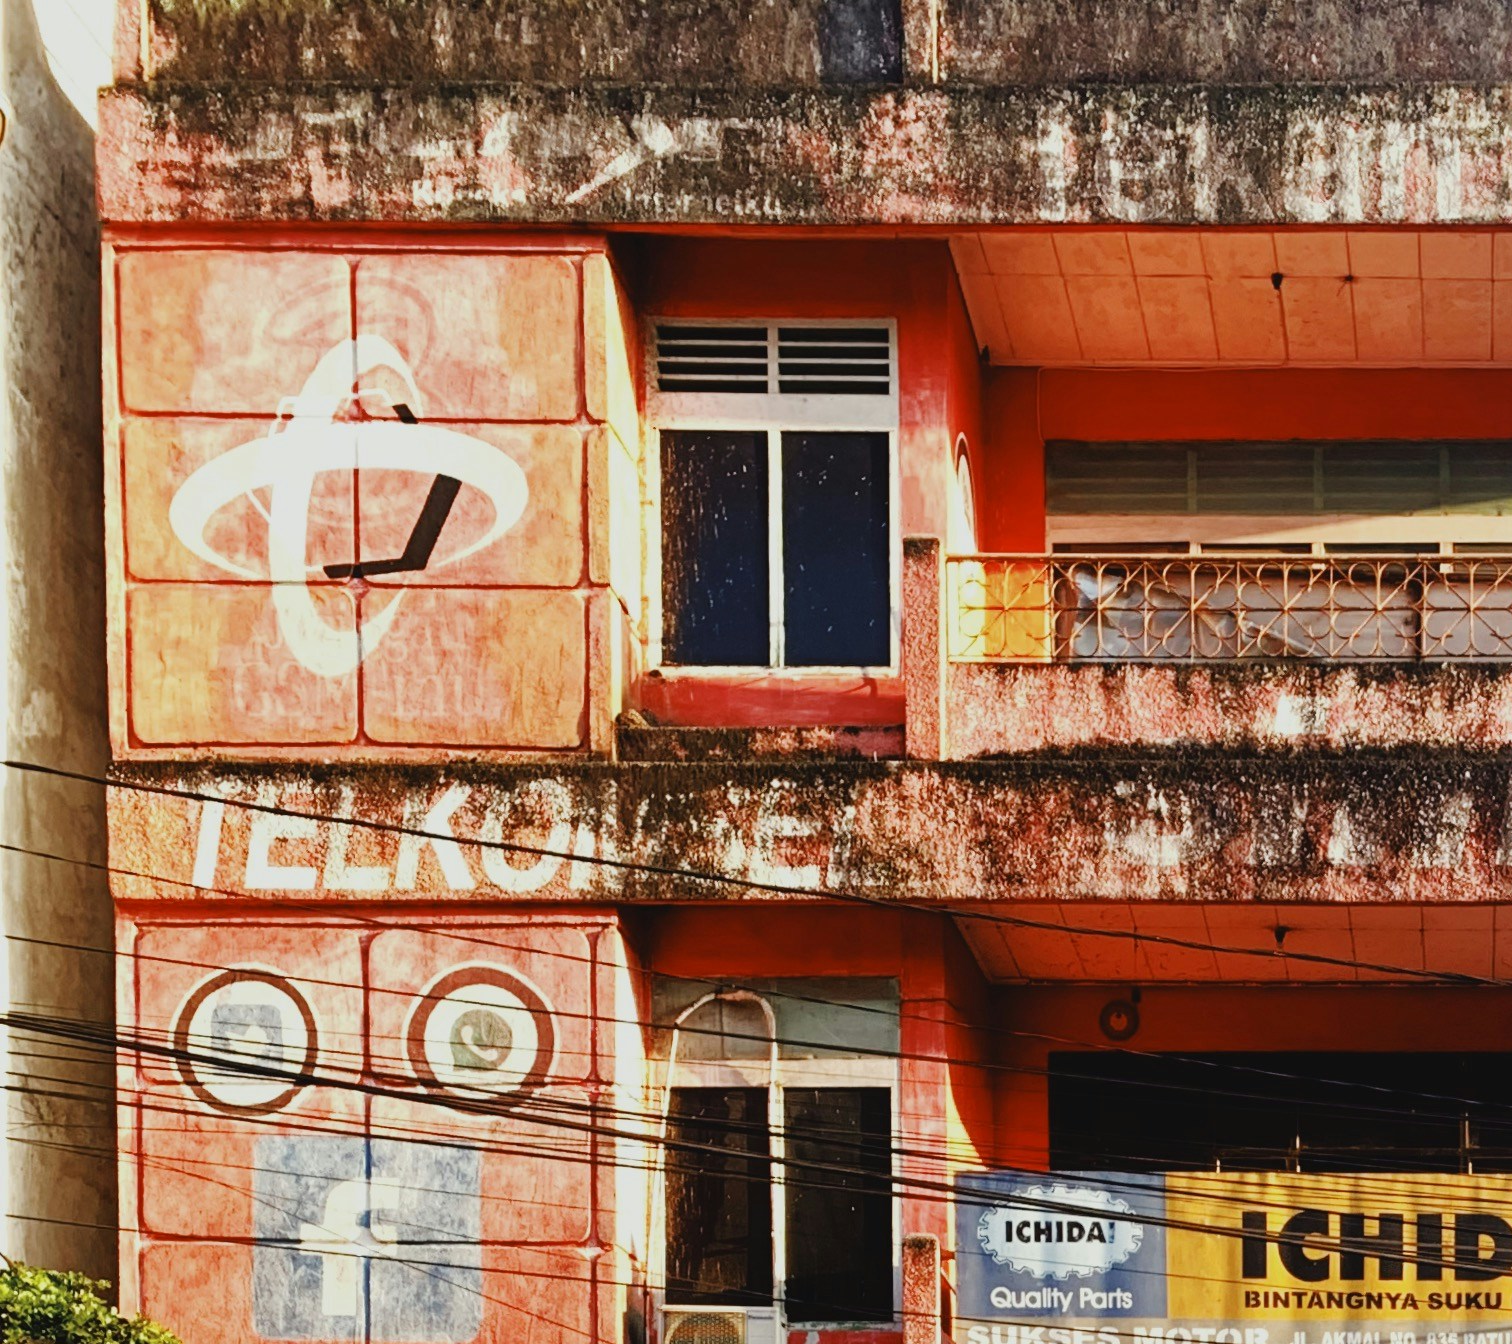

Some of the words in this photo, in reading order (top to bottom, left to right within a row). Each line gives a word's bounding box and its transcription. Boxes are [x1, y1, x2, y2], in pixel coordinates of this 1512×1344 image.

[1005, 1220, 1116, 1244] ICHIDAI
[990, 1286, 1074, 1313] Quality
[1079, 1287, 1134, 1309] Parts
[1244, 1290, 1420, 1310] BINTANGNYA
[1427, 1292, 1503, 1310] SUKU
